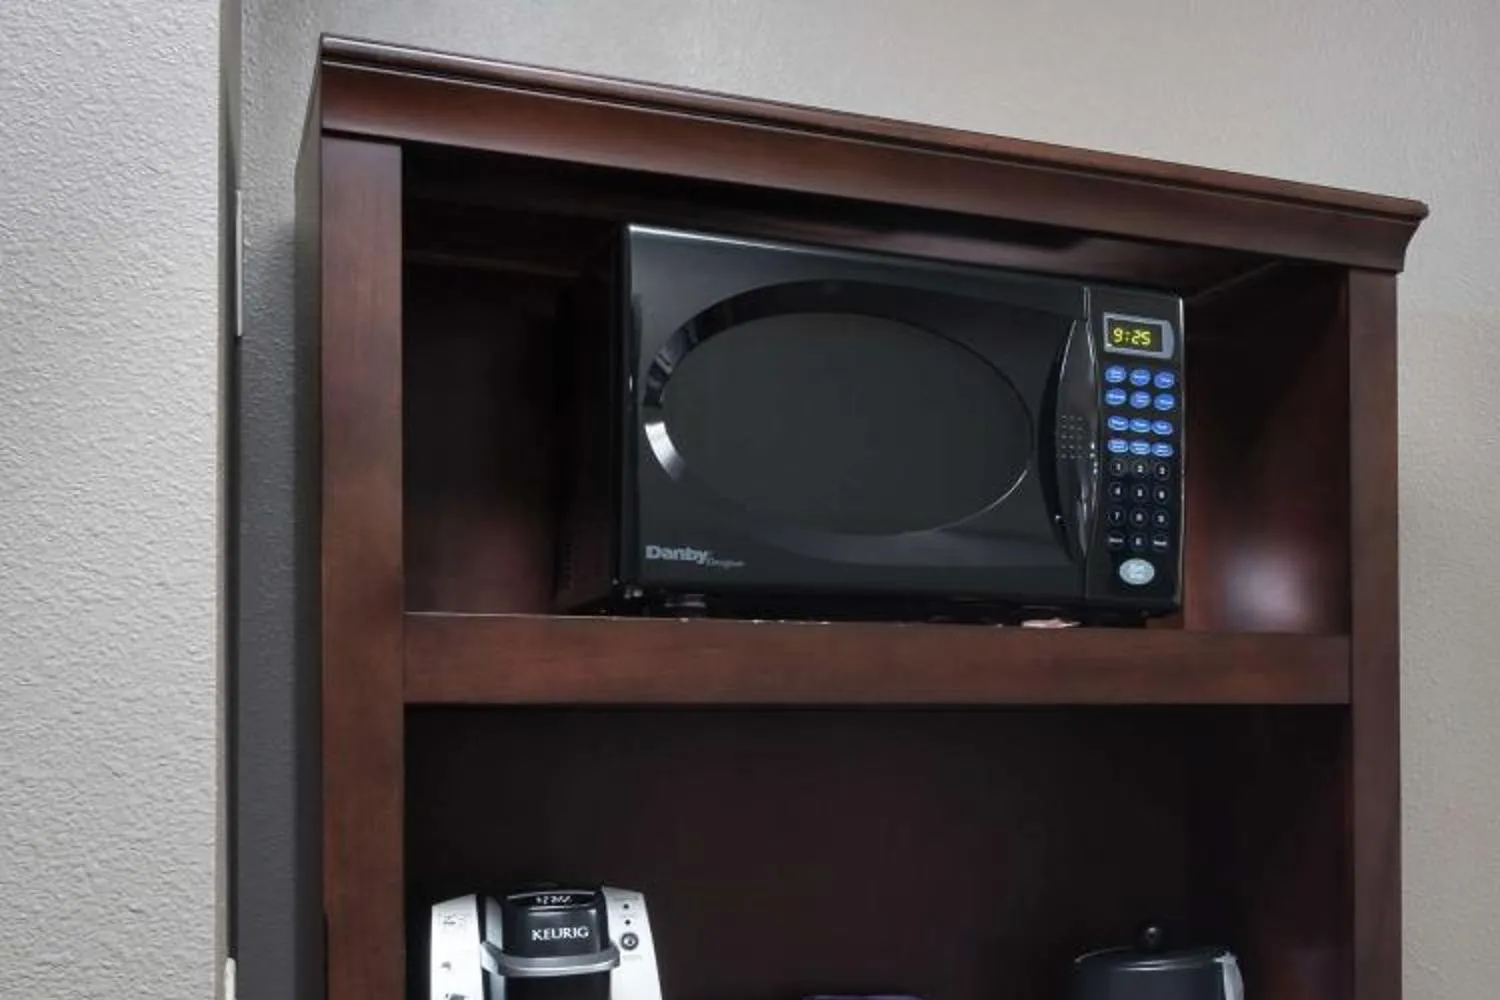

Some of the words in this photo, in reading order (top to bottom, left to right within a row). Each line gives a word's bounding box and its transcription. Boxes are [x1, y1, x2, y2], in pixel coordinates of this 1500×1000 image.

[1113, 326, 1151, 346] 9:25
[644, 544, 708, 565] Danby
[531, 925, 590, 941] KEURIG
